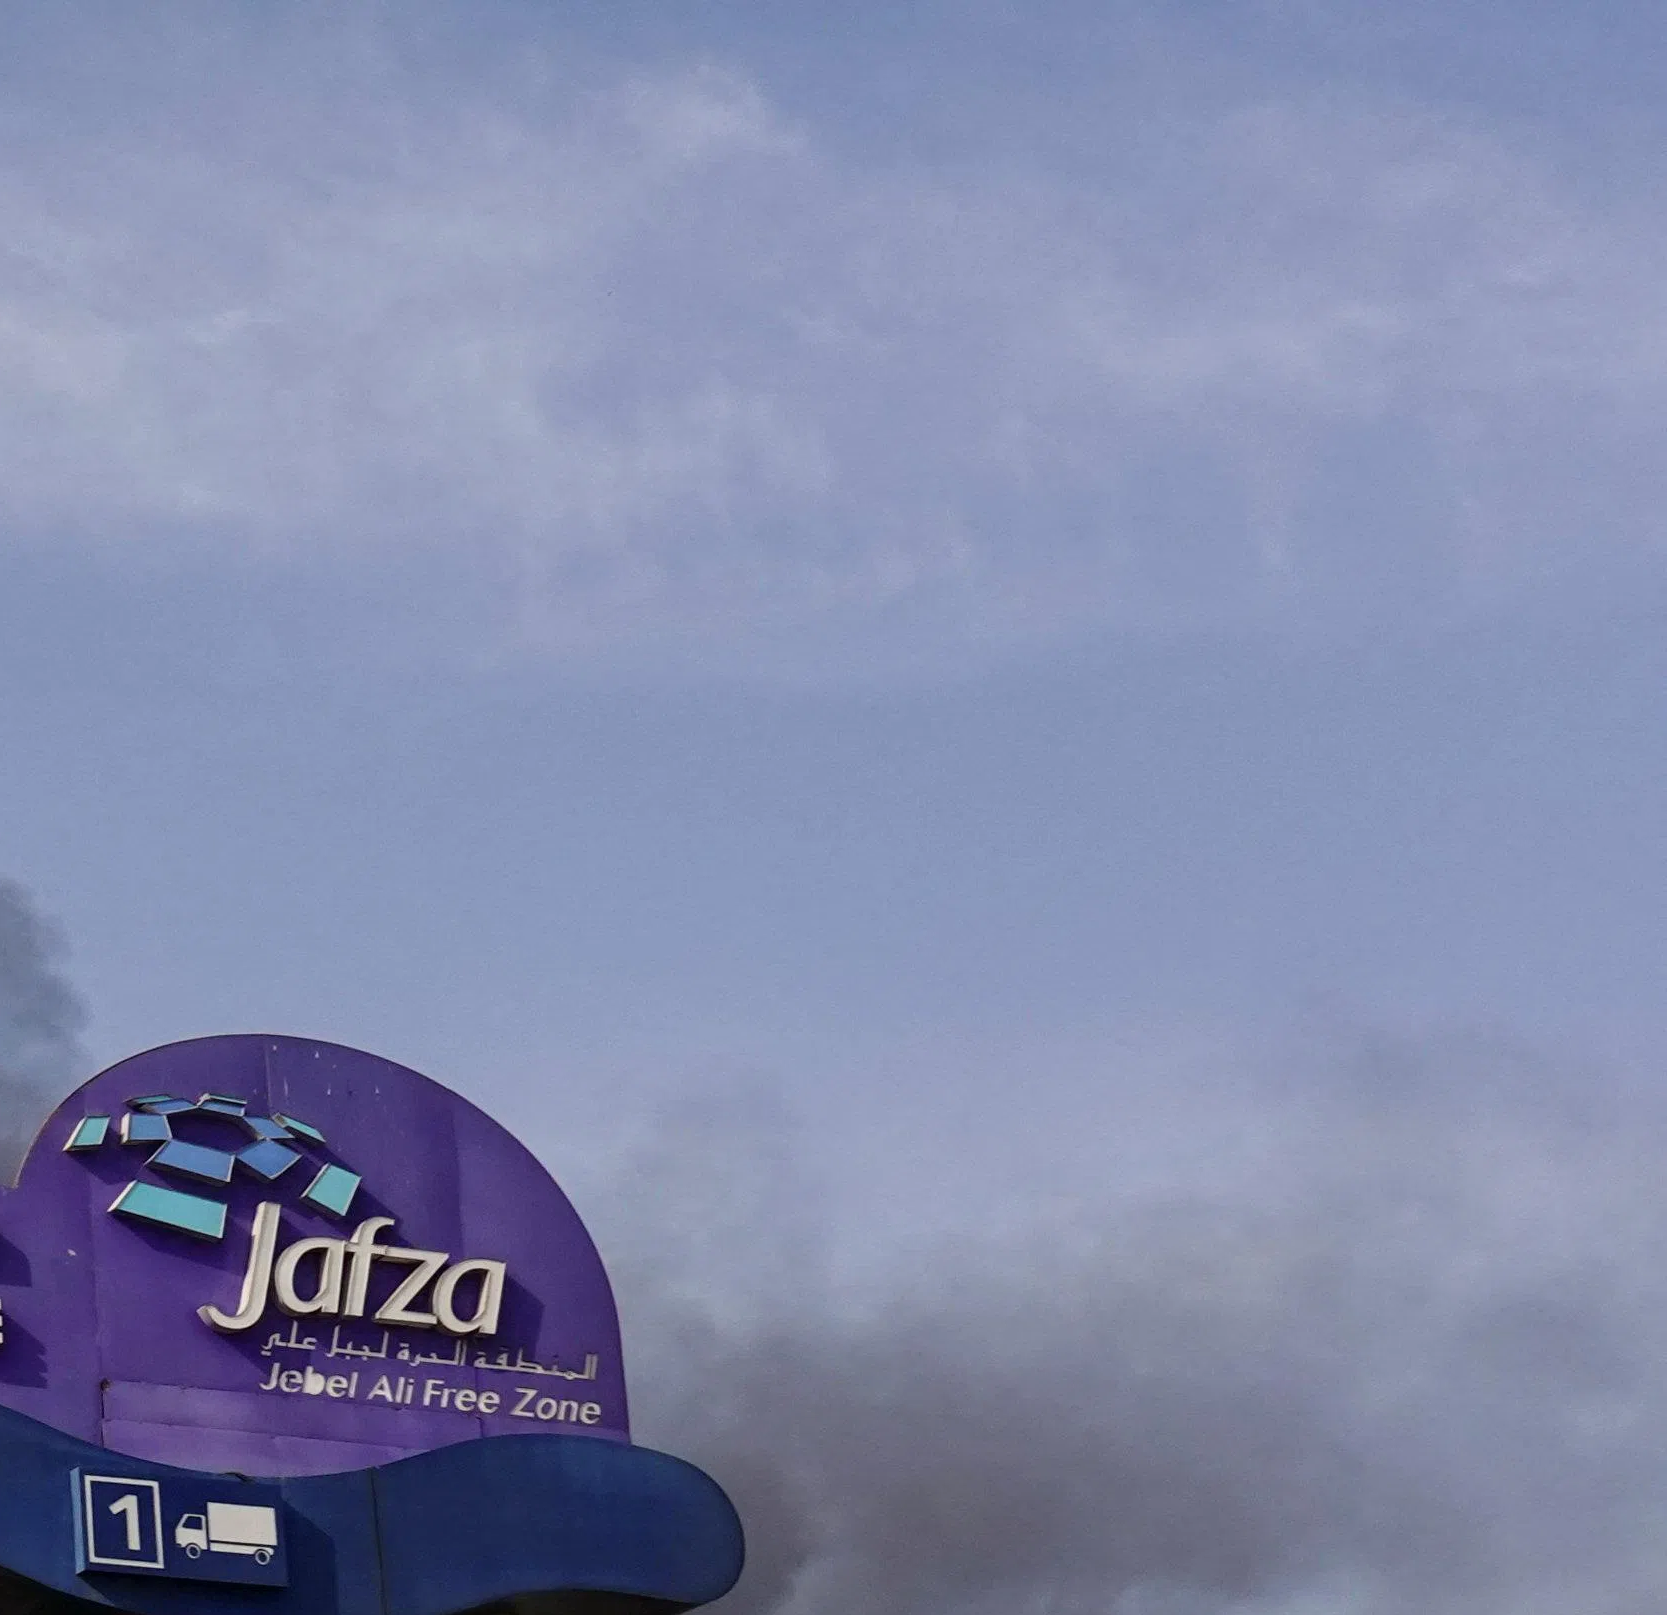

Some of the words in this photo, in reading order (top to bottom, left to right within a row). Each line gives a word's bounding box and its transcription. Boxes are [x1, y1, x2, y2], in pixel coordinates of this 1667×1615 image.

[196, 1201, 506, 1336] Jafza
[261, 1322, 317, 1356] علي
[474, 1348, 598, 1380] المنطقة
[260, 1363, 358, 1398] Jebel
[367, 1375, 415, 1404] Ali
[423, 1379, 500, 1413] Free
[511, 1388, 601, 1424] Zone
[108, 1495, 141, 1551] 1
